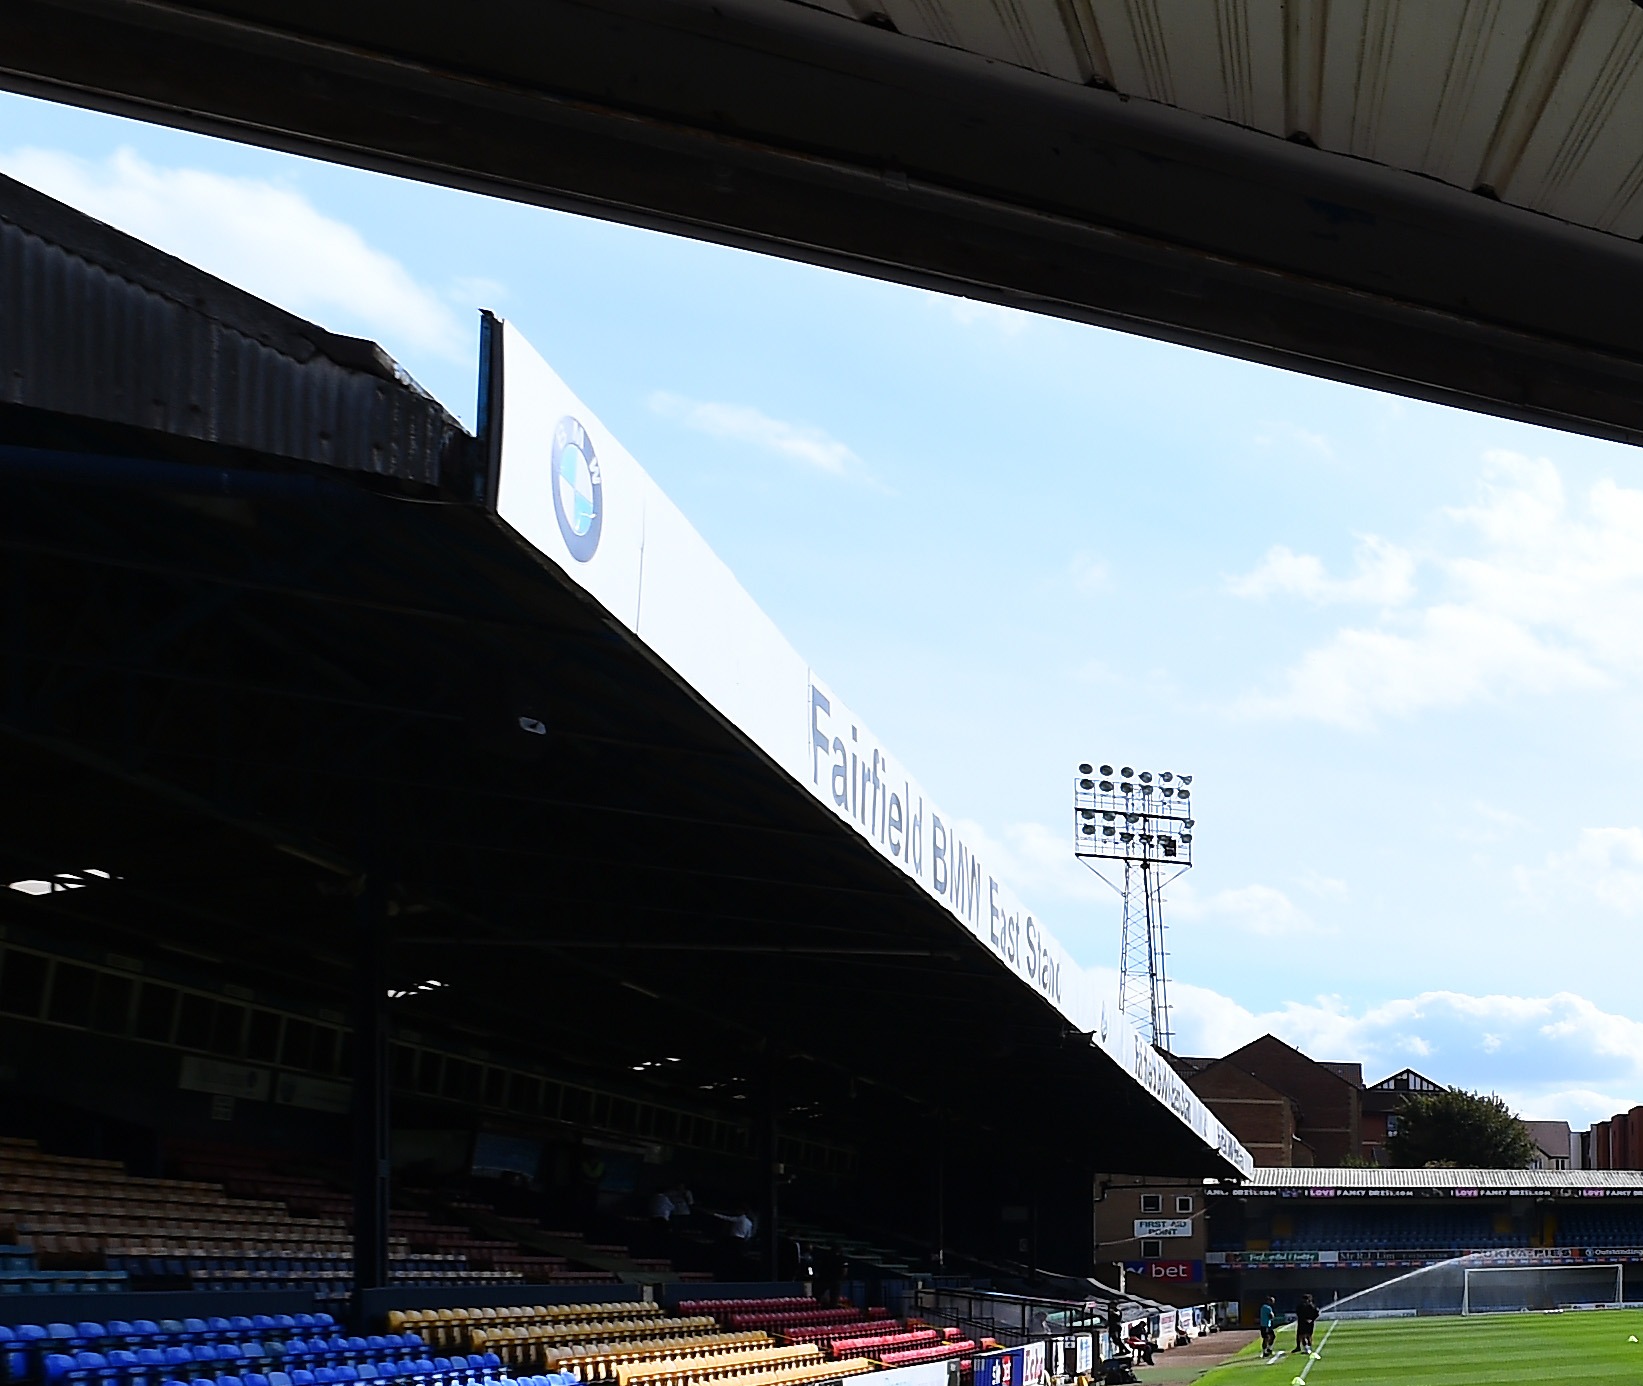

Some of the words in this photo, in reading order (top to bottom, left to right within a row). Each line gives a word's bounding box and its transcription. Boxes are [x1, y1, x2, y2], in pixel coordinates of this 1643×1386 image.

[811, 684, 923, 877] Fairfield
[932, 812, 981, 928] BMW
[989, 875, 1020, 970] East
[1151, 1263, 1188, 1278] bet
